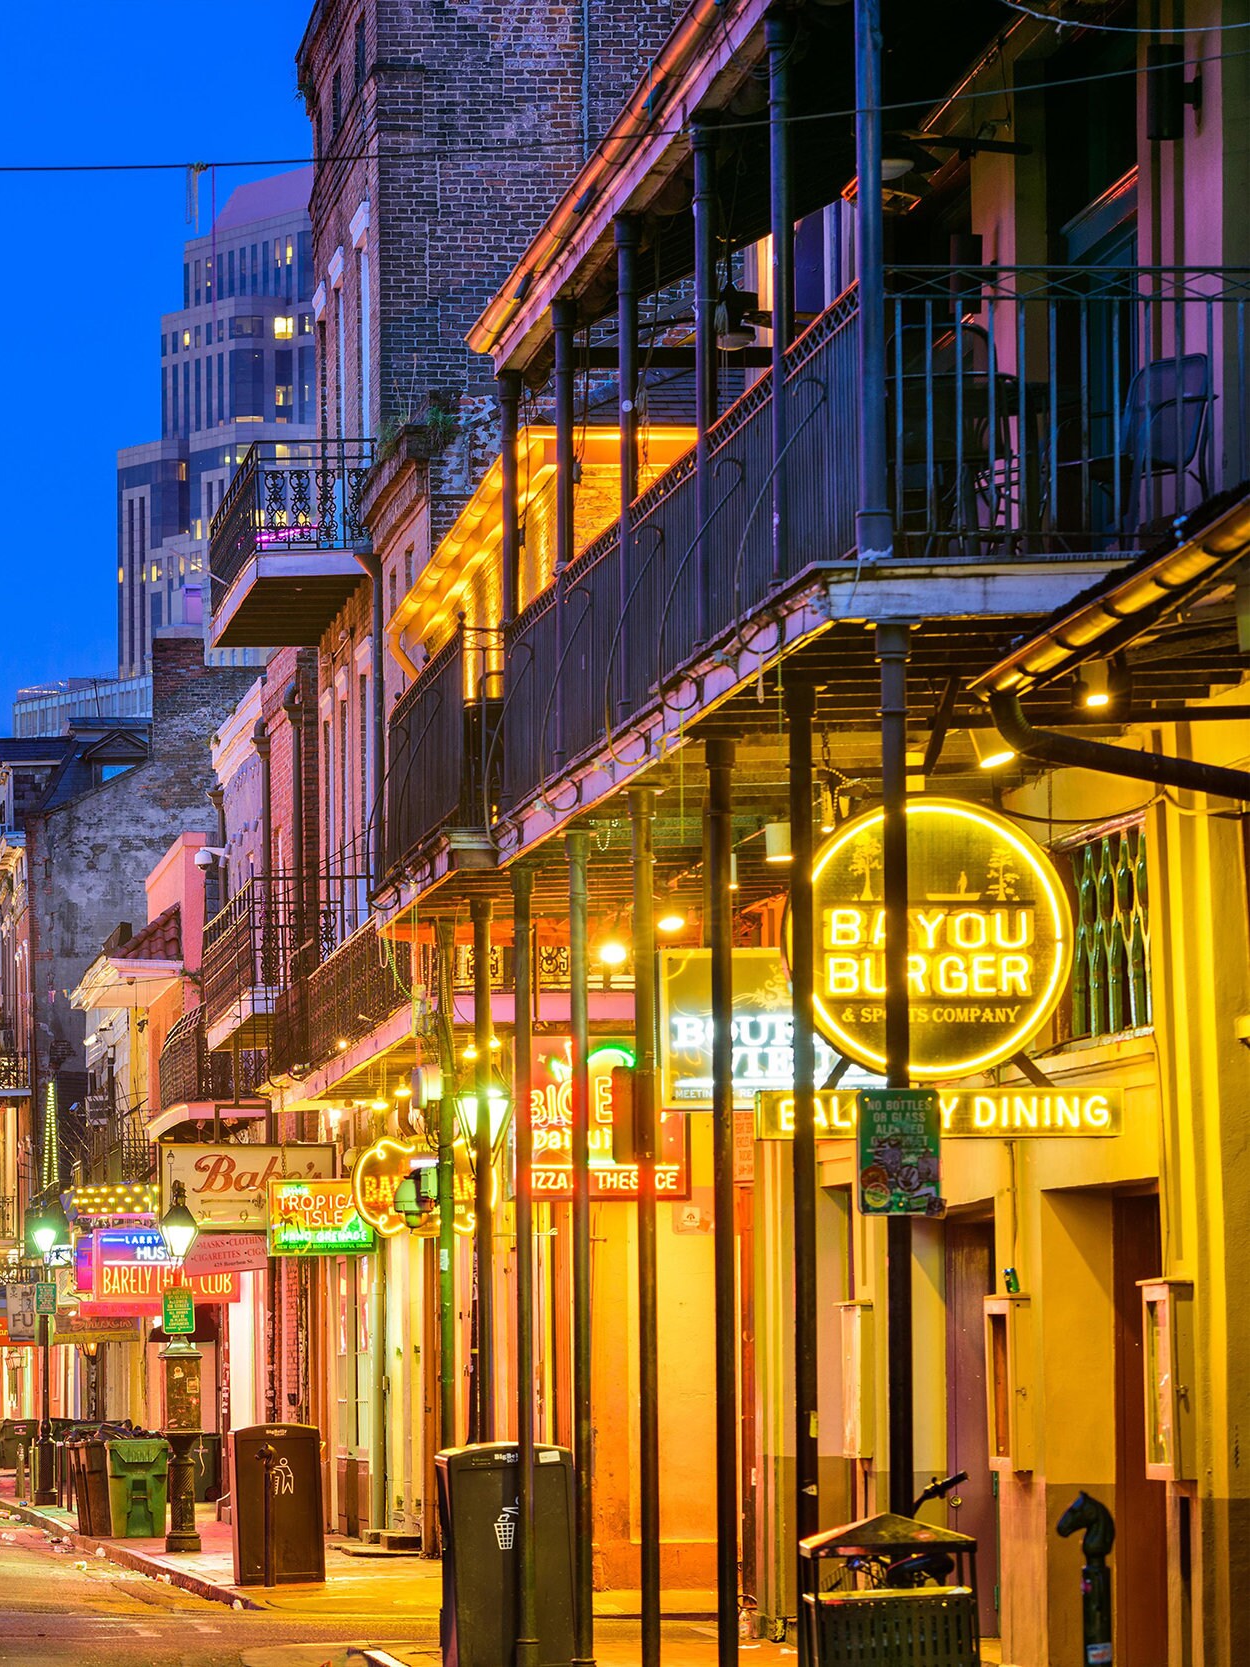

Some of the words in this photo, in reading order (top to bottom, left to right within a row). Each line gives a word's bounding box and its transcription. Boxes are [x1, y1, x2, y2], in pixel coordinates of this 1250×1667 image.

[824, 952, 1033, 997] BURGER
[841, 1008, 856, 1023] &
[861, 1008, 929, 1023] SPTS
[933, 1005, 1021, 1023] COMPANY
[779, 1096, 959, 1131] BALY
[973, 1095, 1111, 1129] DINING
[866, 1100, 882, 1111] NO
[886, 1100, 932, 1111] BOTTLES
[873, 1112, 888, 1123] OR
[891, 1112, 926, 1122] GLASS
[875, 1124, 925, 1135] ALLED
[531, 1171, 569, 1189] IZZA
[629, 1171, 679, 1190] SCE
[276, 1193, 355, 1211] TROPICA
[305, 1210, 343, 1226] ISLE
[125, 1235, 160, 1244] LARRY
[199, 1239, 226, 1250] MASKS
[194, 1250, 241, 1263] CIGARETTES
[247, 1247, 267, 1256] CIGA
[102, 1266, 151, 1295] BARELY
[200, 1271, 233, 1295] CLUB
[493, 1452, 519, 1461] BigBe
